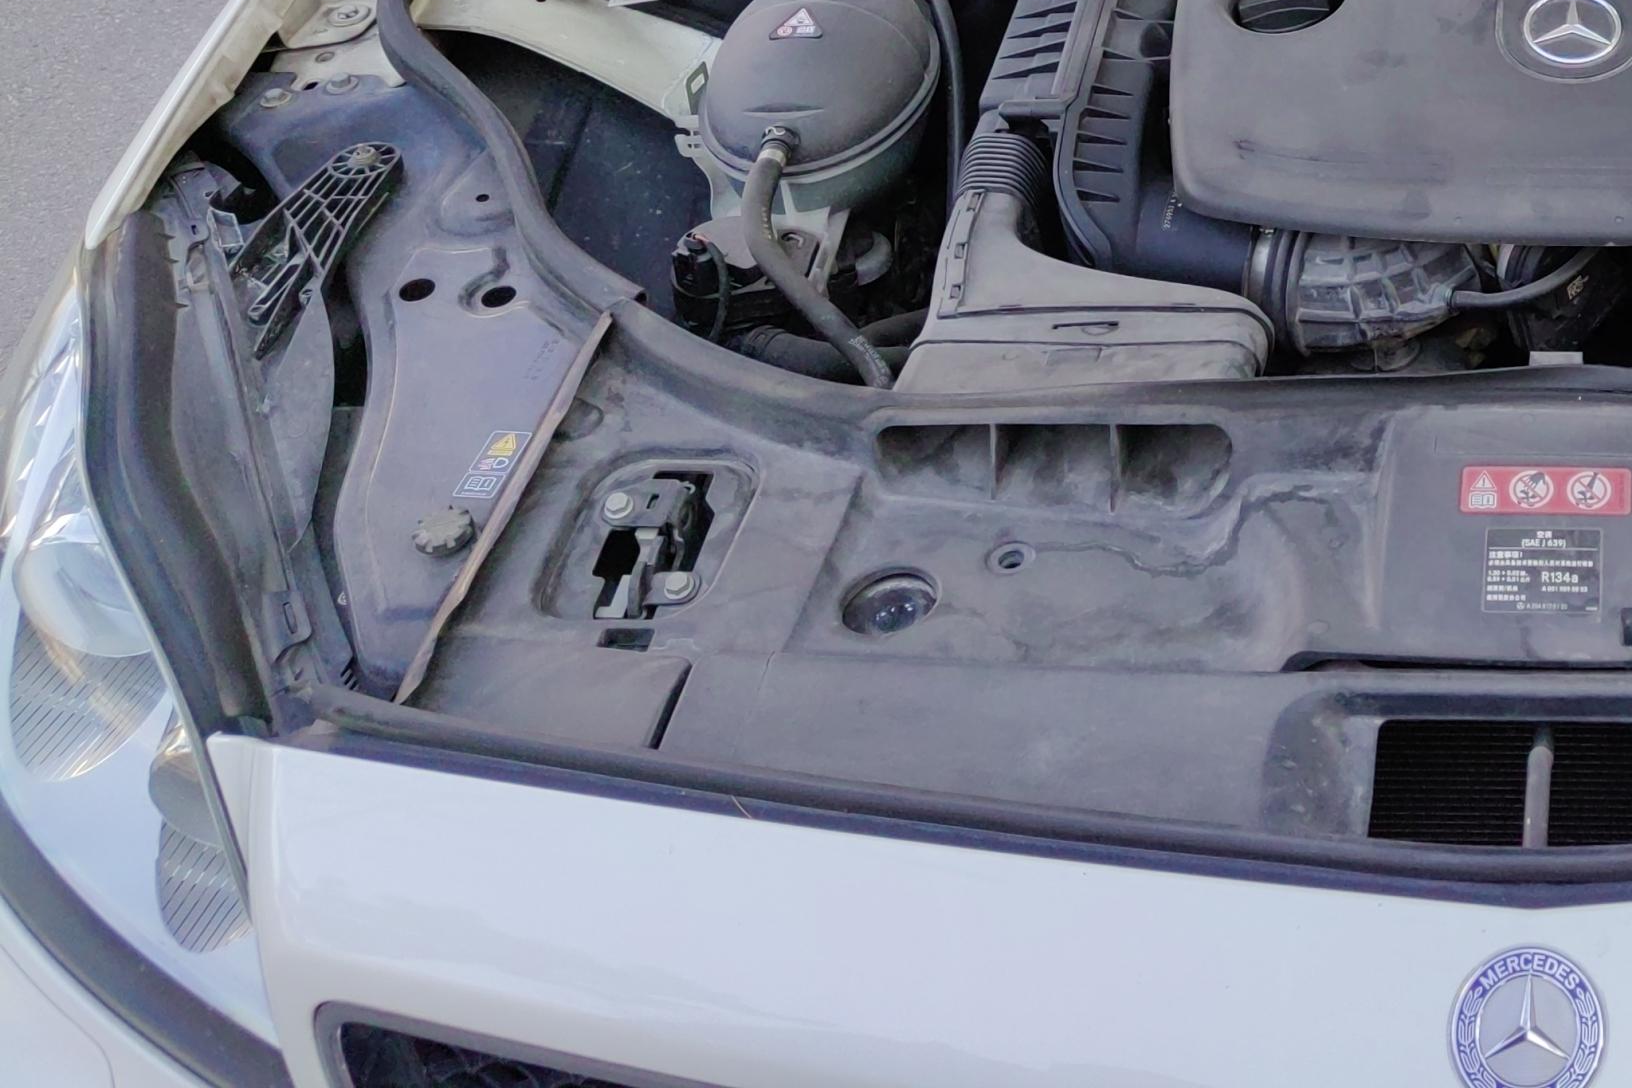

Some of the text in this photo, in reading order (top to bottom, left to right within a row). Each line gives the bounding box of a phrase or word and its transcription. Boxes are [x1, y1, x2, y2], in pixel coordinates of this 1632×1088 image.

[1521, 539, 1540, 548] (SAE
[1541, 571, 1579, 584] R134a
[1479, 953, 1580, 991] MERCEDES
